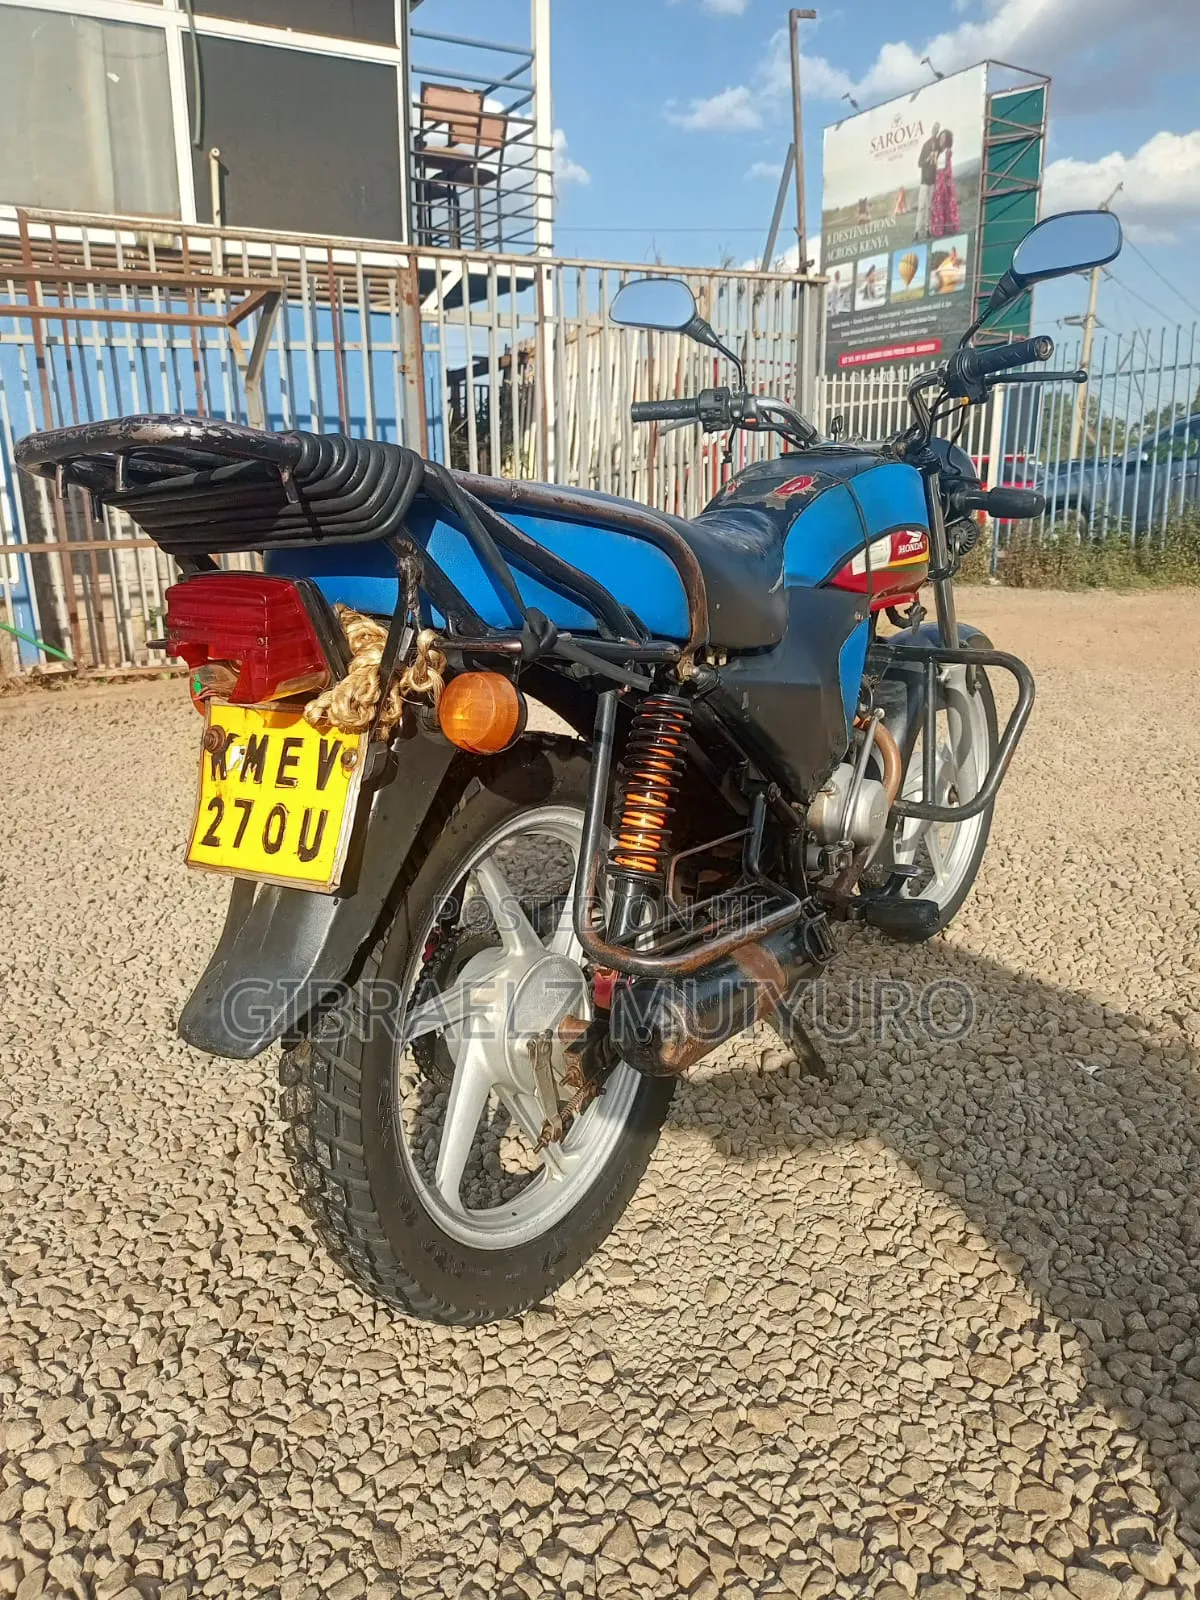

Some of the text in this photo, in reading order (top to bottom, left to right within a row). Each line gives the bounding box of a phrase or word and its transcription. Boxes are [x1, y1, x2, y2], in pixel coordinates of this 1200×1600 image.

[869, 120, 924, 154] SAROVA
[832, 217, 897, 245] DESTINATIONS
[859, 234, 889, 253] KENYA
[897, 542, 923, 555] HONDA
[200, 797, 329, 862] 270U
